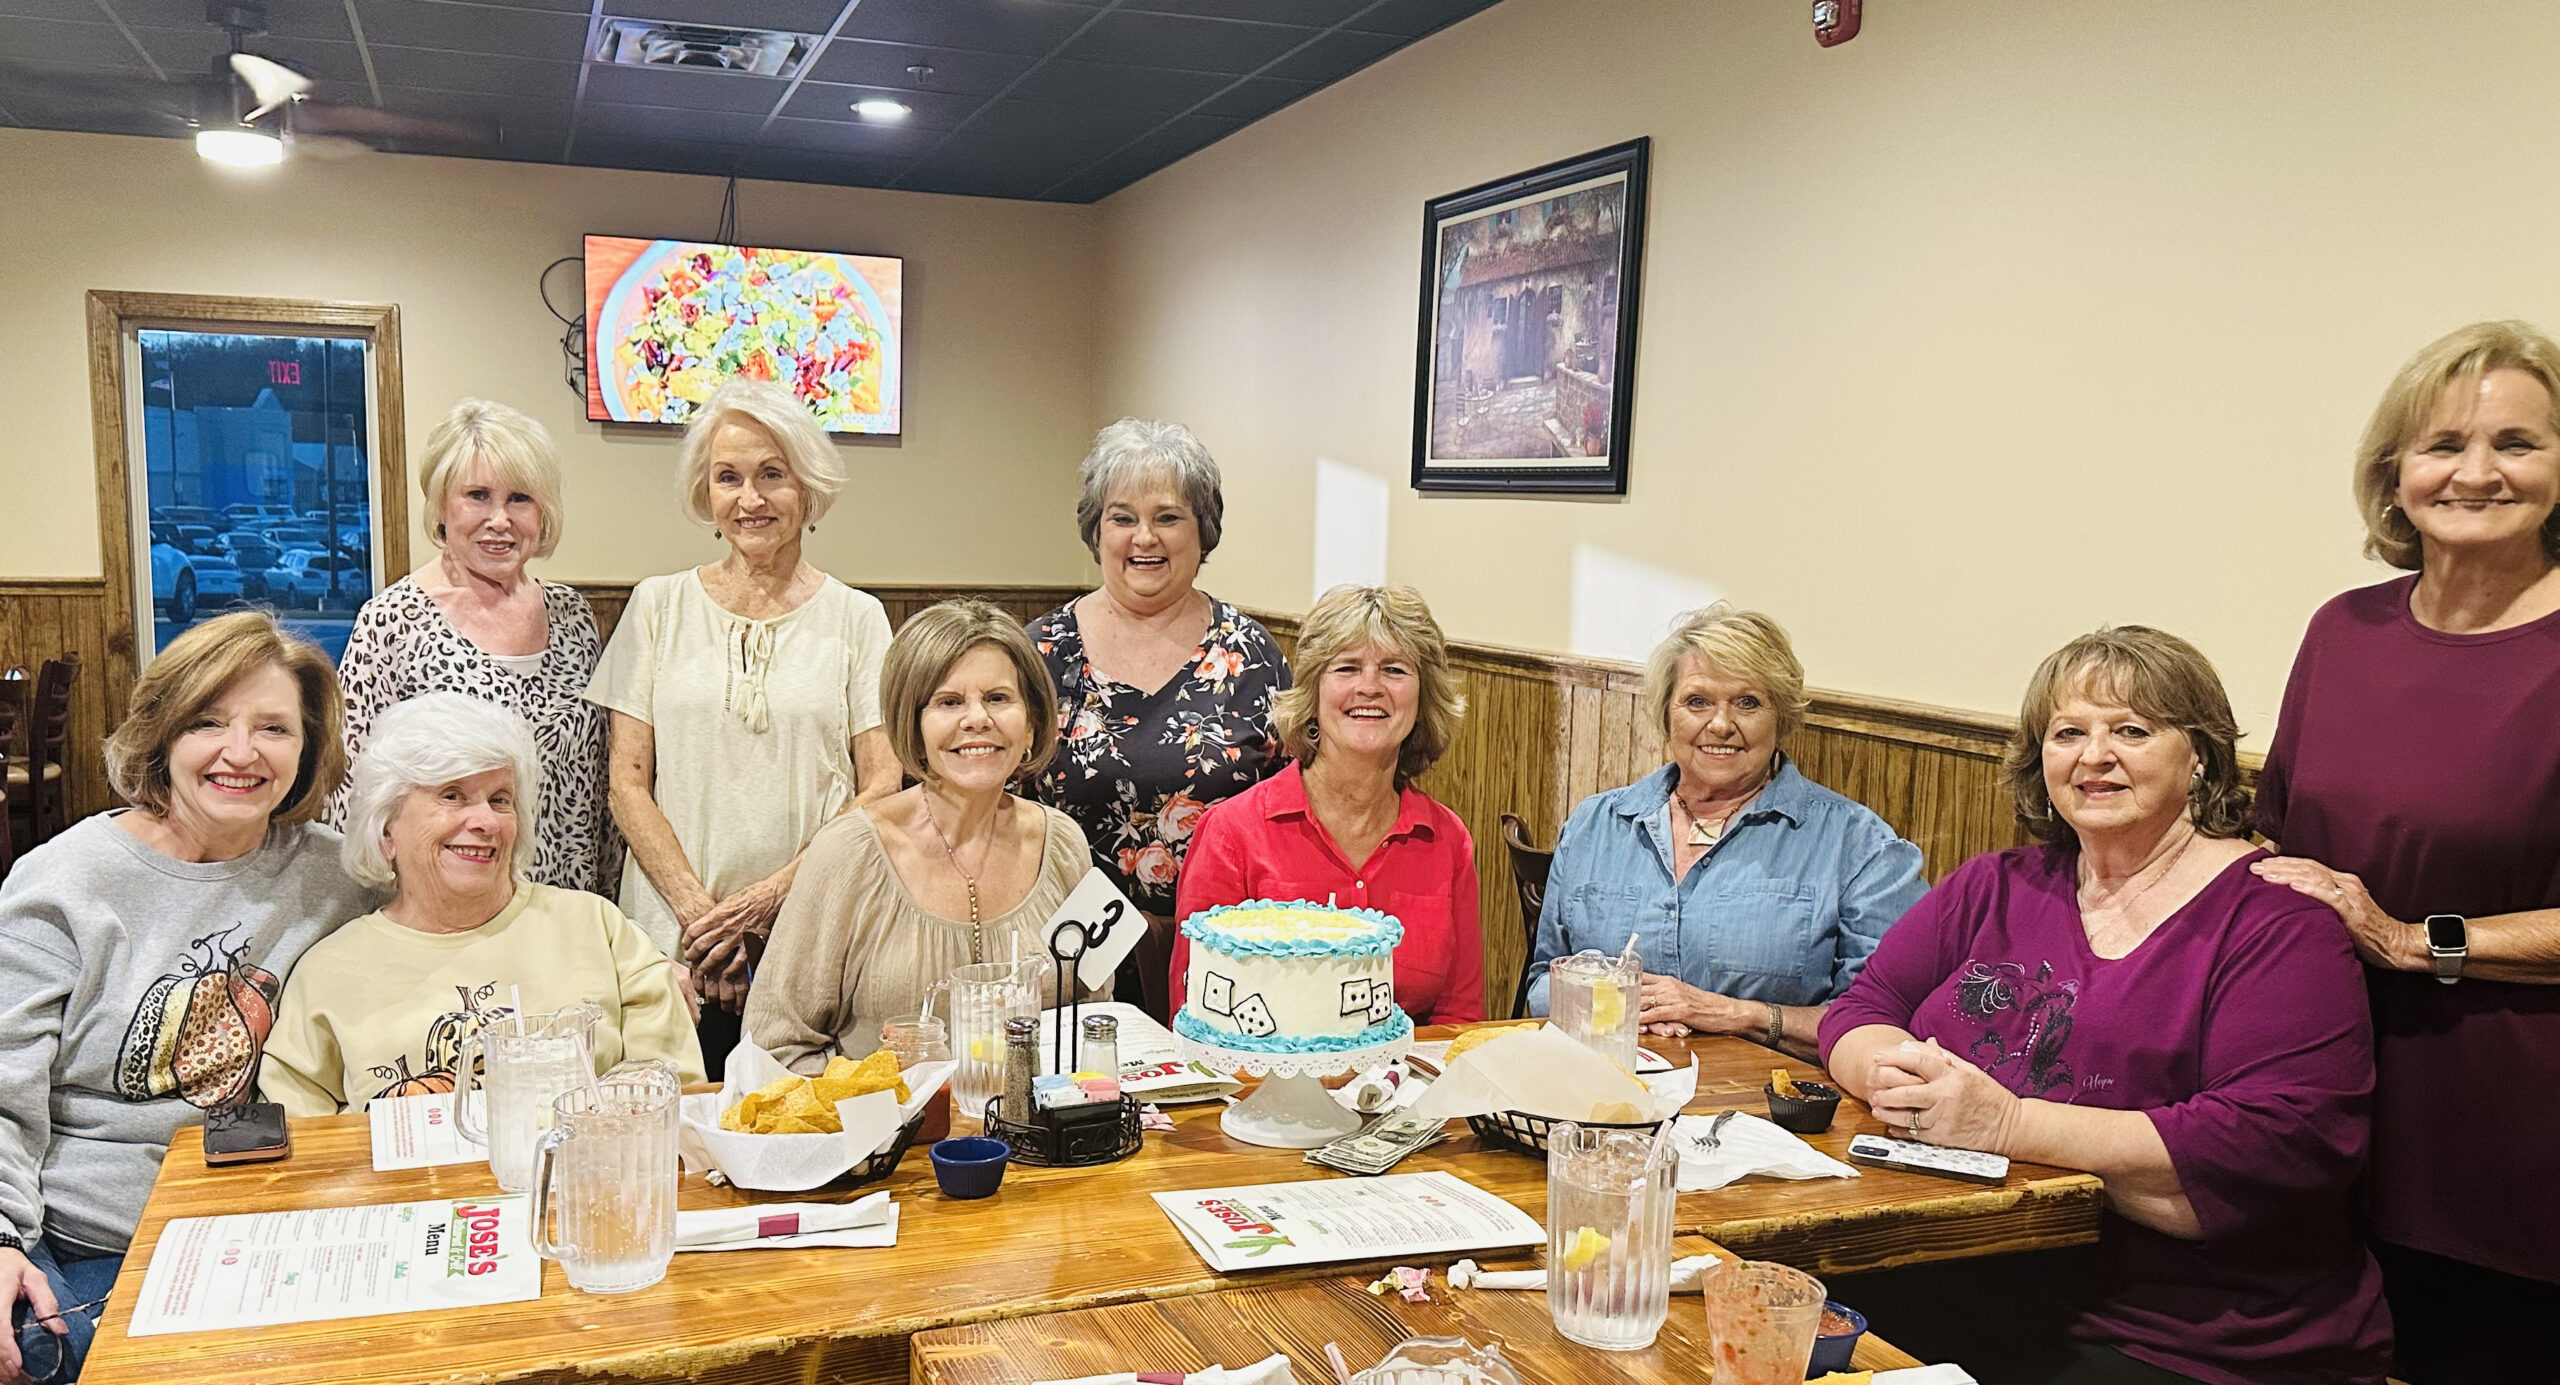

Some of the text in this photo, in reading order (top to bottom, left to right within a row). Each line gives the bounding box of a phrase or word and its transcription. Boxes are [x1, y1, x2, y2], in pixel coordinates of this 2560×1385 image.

[1087, 899, 1124, 949] 3
[2082, 1073, 2115, 1091] Hope
[1195, 1199, 1275, 1235] JOSE'S
[425, 1223, 446, 1256] Menu
[457, 1205, 508, 1276] JOSE'S
